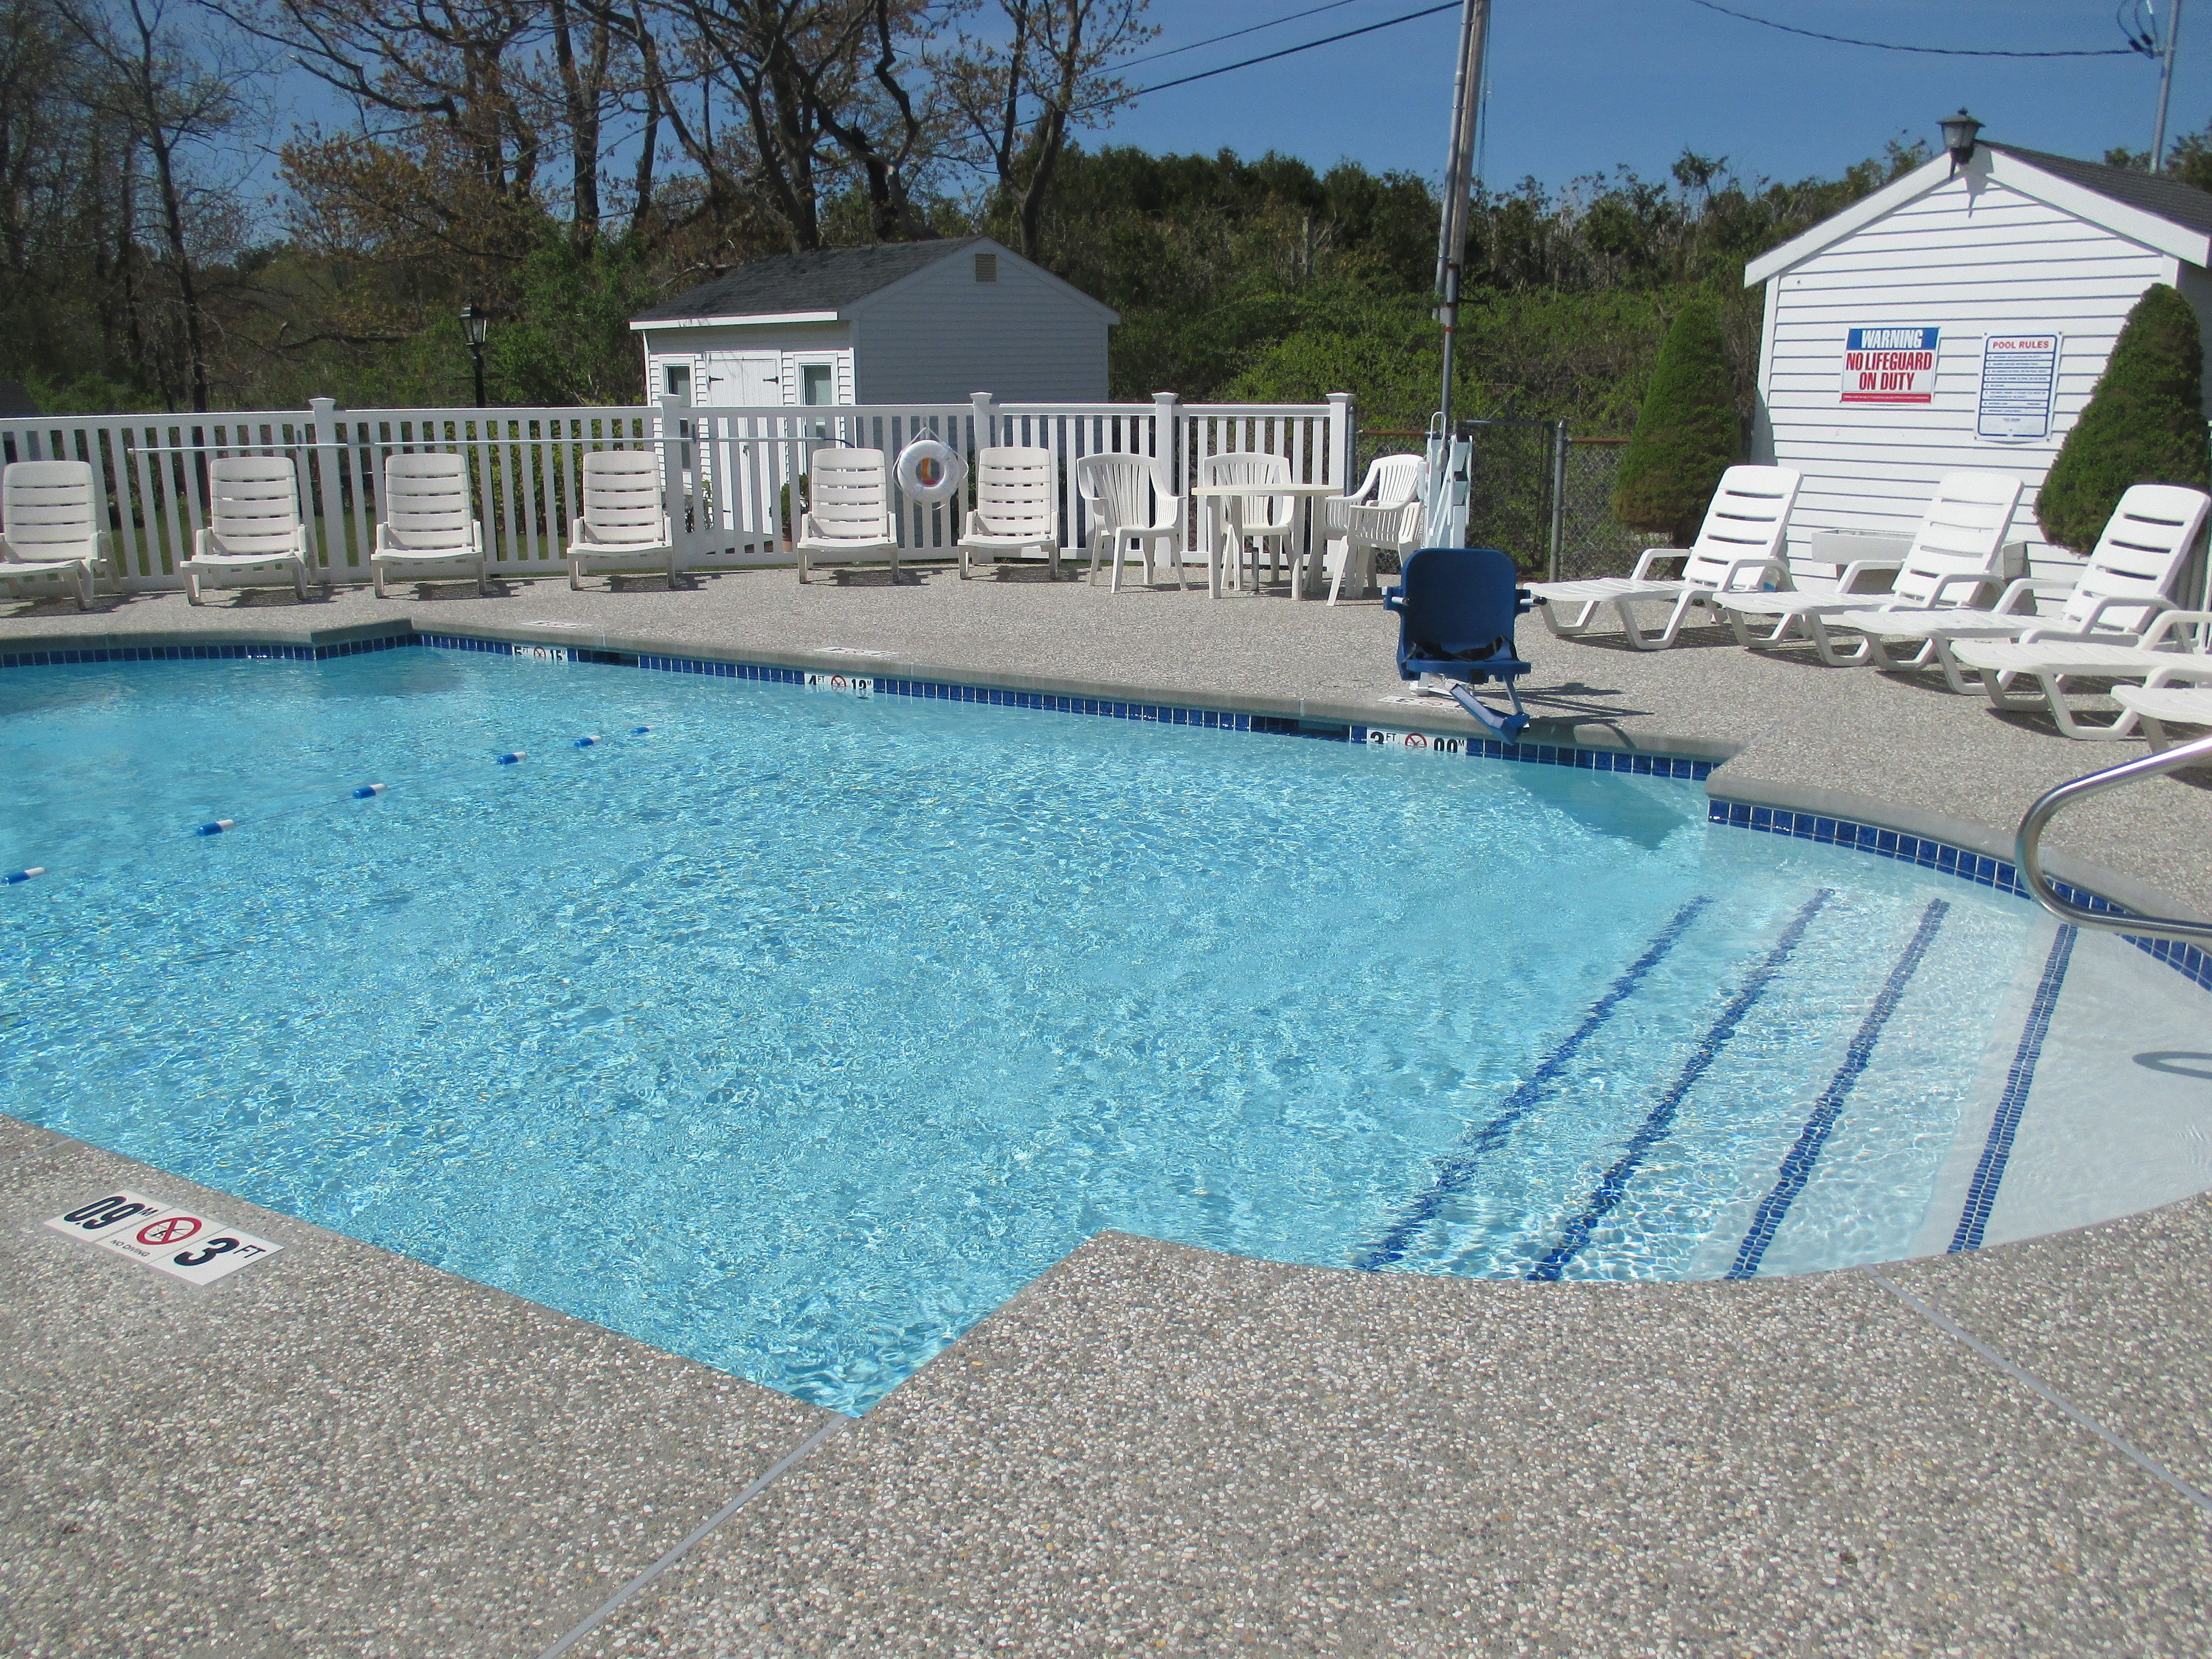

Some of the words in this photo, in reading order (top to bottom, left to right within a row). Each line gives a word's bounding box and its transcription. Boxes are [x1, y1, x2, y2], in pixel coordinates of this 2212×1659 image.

[1861, 329, 1923, 349] WARNING
[1993, 341, 2016, 349] POOL
[2018, 340, 2050, 349] RULES
[1846, 353, 1864, 371] NO
[1865, 352, 1933, 371] LIFEGUARD
[1859, 372, 1876, 391] ON
[1880, 372, 1915, 391] DUTY
[110, 1238, 125, 1247] NO
[122, 1244, 150, 1257] DIVING
[173, 1237, 240, 1267] 3
[232, 1244, 267, 1259] FT
